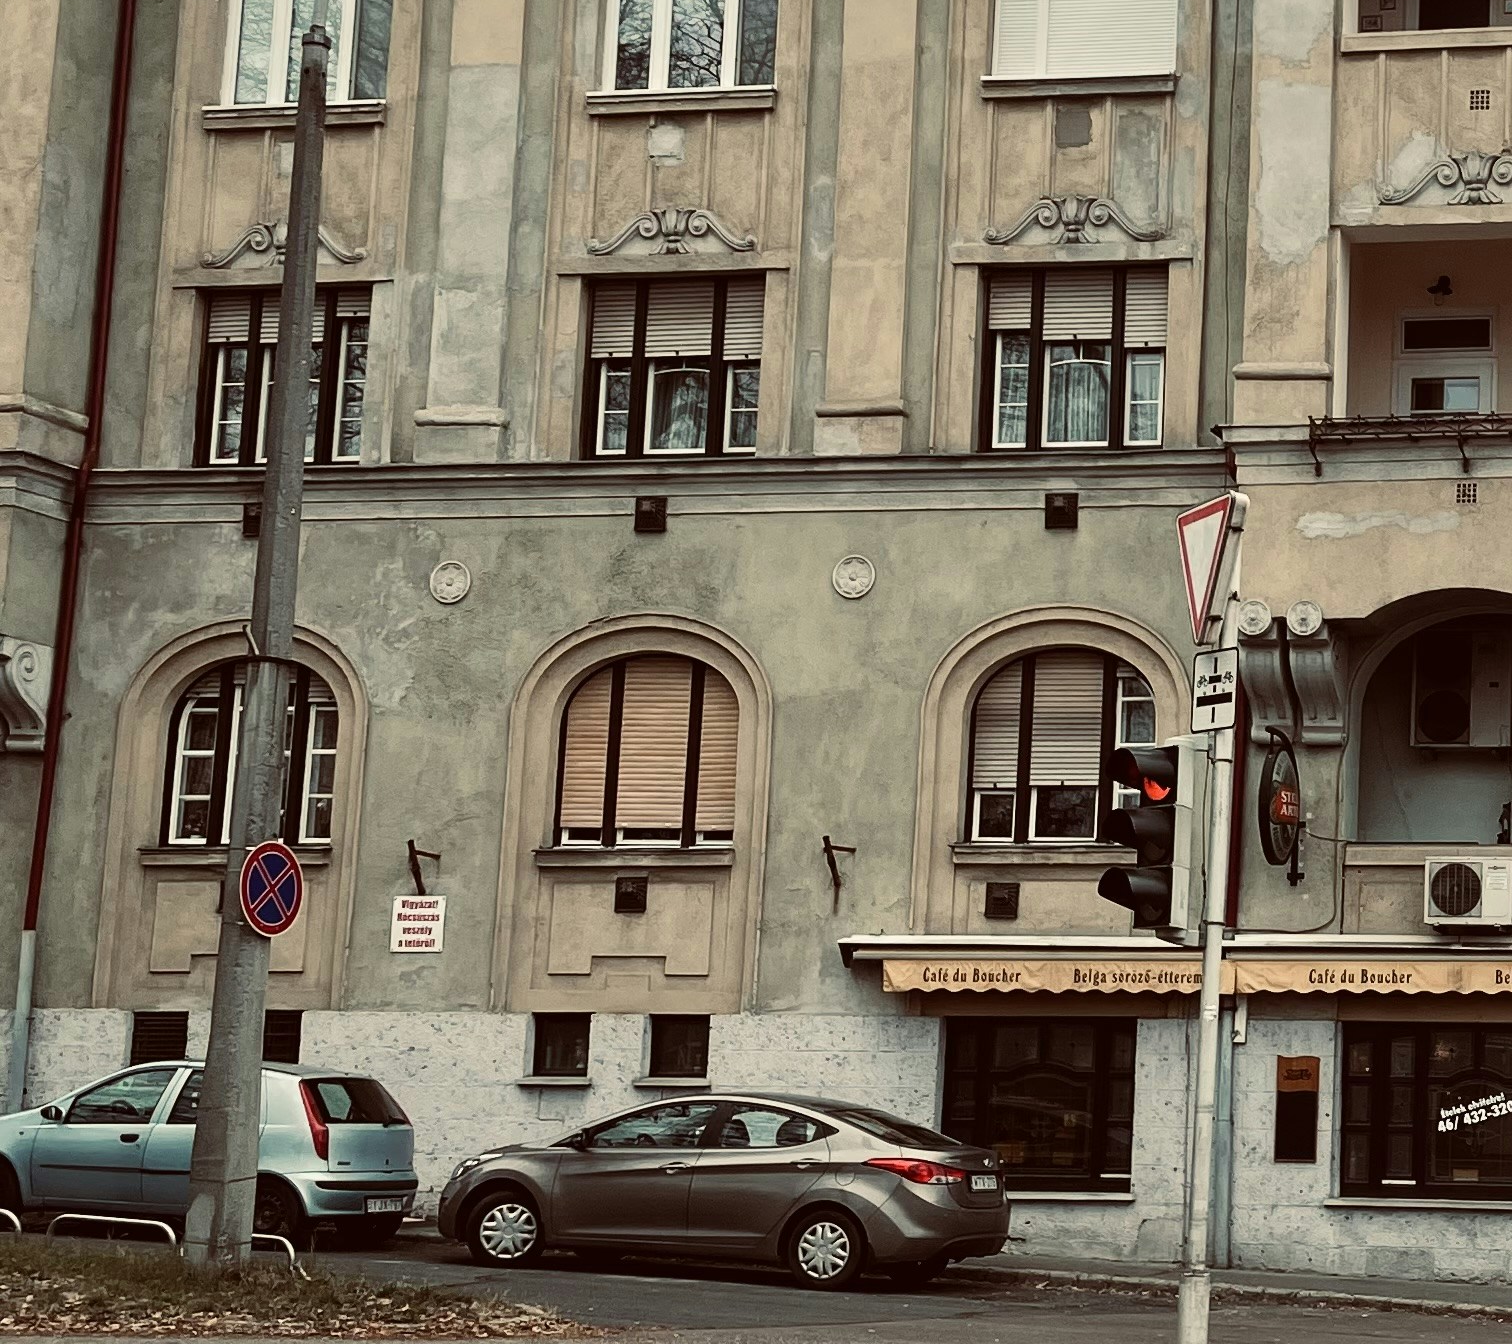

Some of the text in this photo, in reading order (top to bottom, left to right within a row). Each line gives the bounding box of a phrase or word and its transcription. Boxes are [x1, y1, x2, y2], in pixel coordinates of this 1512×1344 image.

[923, 966, 1021, 983] Café du Boucher
[1073, 968, 1107, 986] Belga
[1308, 968, 1413, 984] Café du Boucher
[1437, 1115, 1459, 1132] 46/
